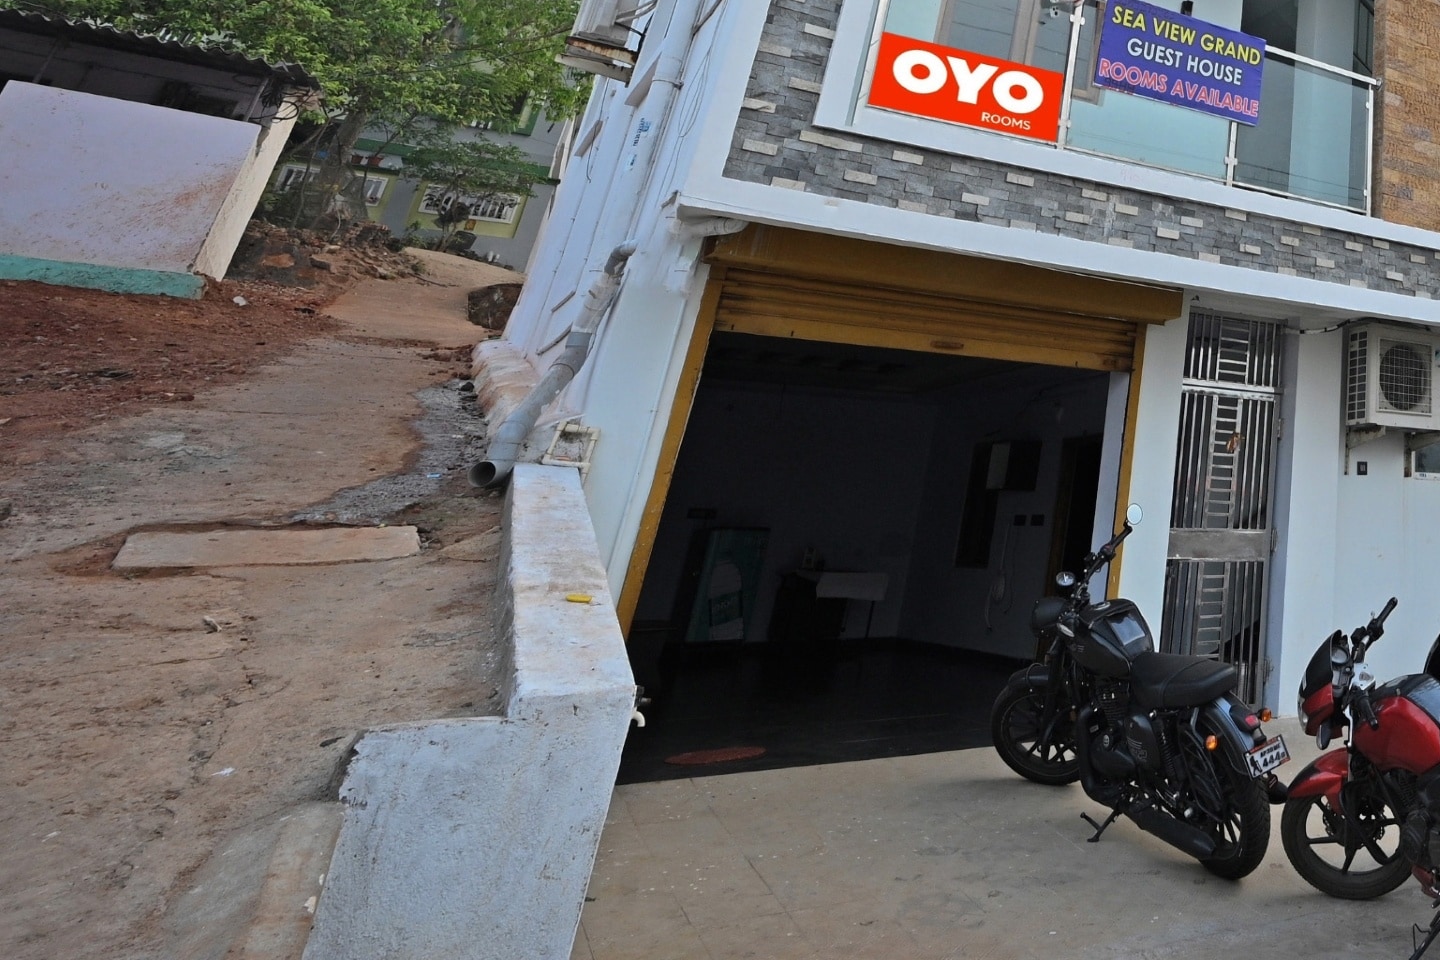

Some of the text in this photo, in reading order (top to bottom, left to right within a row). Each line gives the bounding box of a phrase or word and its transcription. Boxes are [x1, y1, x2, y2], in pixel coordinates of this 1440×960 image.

[1111, 5, 1146, 32] SEA
[1152, 17, 1197, 46] VIEW
[1200, 33, 1261, 65] GRAND
[1127, 37, 1243, 86] GUEST HOUSE
[892, 49, 1044, 114] OYO
[1098, 58, 1259, 117] ROOMS AVAILABLE
[981, 111, 1031, 131] ROOMS
